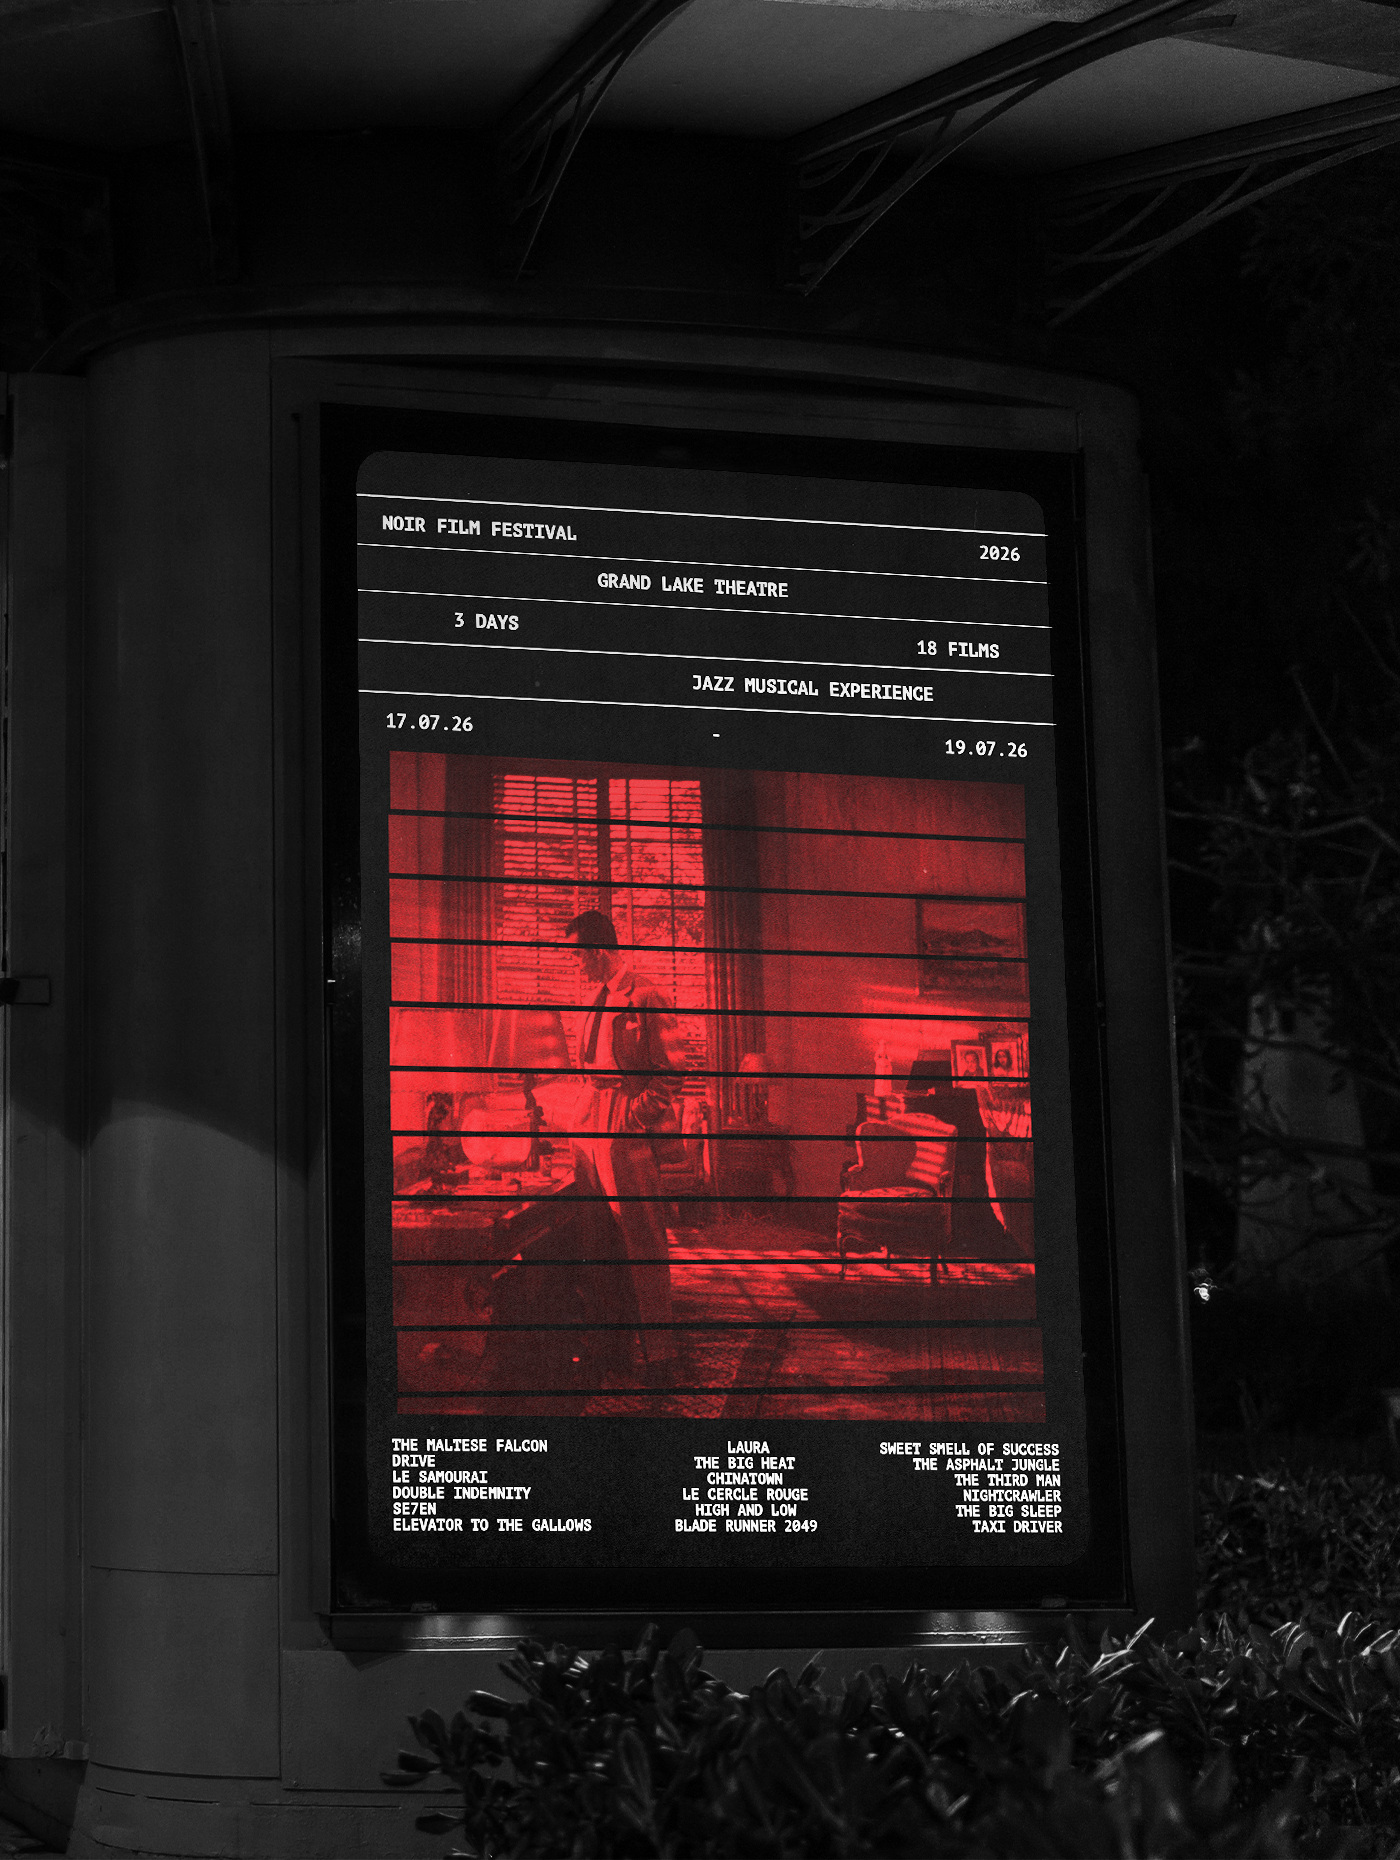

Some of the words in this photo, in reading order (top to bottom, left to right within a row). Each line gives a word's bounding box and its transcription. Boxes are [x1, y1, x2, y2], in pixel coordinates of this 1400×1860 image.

[382, 514, 426, 533] NOIR
[437, 518, 481, 536] FILM
[491, 521, 577, 541] FESTIVAL
[979, 544, 1021, 562] 2026
[597, 572, 652, 591] GRAND
[661, 575, 705, 594] LAKE
[713, 578, 789, 598] THEATRE
[454, 611, 465, 628] 3
[475, 613, 520, 631] DAYS
[916, 639, 938, 656] 18
[948, 641, 1000, 659] FILMS
[692, 674, 735, 692] JAZZ
[744, 677, 819, 697] MUSICAL
[829, 681, 934, 702] EXPERIENCE
[386, 712, 474, 732] 17.07.26
[945, 738, 1028, 758] 19.07.26
[391, 1437, 419, 1452] THE
[426, 1438, 488, 1452] MALTESE
[495, 1438, 548, 1452] FALCON
[727, 1440, 771, 1455] LAURA
[879, 1441, 922, 1456] SWEET
[928, 1442, 971, 1456] SMELL
[977, 1442, 995, 1456] OF
[1002, 1442, 1060, 1456] SUCCESS
[391, 1453, 436, 1468] DRIVE
[693, 1456, 720, 1470] THE
[727, 1456, 754, 1470] BIG
[760, 1456, 796, 1470] HEAT
[912, 1457, 938, 1471] THE
[945, 1457, 1004, 1472] ASPHALT
[1011, 1458, 1061, 1472] JUNGLE
[392, 1469, 410, 1484] LE
[418, 1470, 489, 1484] SAMOURAI
[706, 1471, 784, 1486] CHINATOWN
[953, 1473, 980, 1487] THE
[986, 1473, 1029, 1487] THIRD
[1035, 1473, 1061, 1487] MAN
[392, 1485, 445, 1500] DOUBLE
[453, 1486, 532, 1500] INDEMNITY
[682, 1487, 700, 1501] LE
[707, 1487, 759, 1501] CERCLE
[766, 1487, 809, 1501] ROUGE
[962, 1488, 1062, 1503] NIGHTCRAWLER
[392, 1501, 437, 1516] SE7EN
[695, 1503, 730, 1517] HIGH
[737, 1503, 764, 1517] AND
[770, 1503, 798, 1517] LOW
[954, 1504, 981, 1518] THE
[988, 1504, 1014, 1518] BIG
[1020, 1504, 1062, 1518] SLEEP
[392, 1517, 464, 1532] ELEVATOR
[470, 1518, 490, 1532] TO
[496, 1518, 524, 1532] THE
[531, 1518, 593, 1532] GALLOWS
[674, 1518, 717, 1533] BLADE
[725, 1518, 777, 1533] RUNNER
[784, 1519, 818, 1533] 2049
[971, 1519, 1006, 1534] TAXI
[1013, 1520, 1063, 1534] DRIVER
